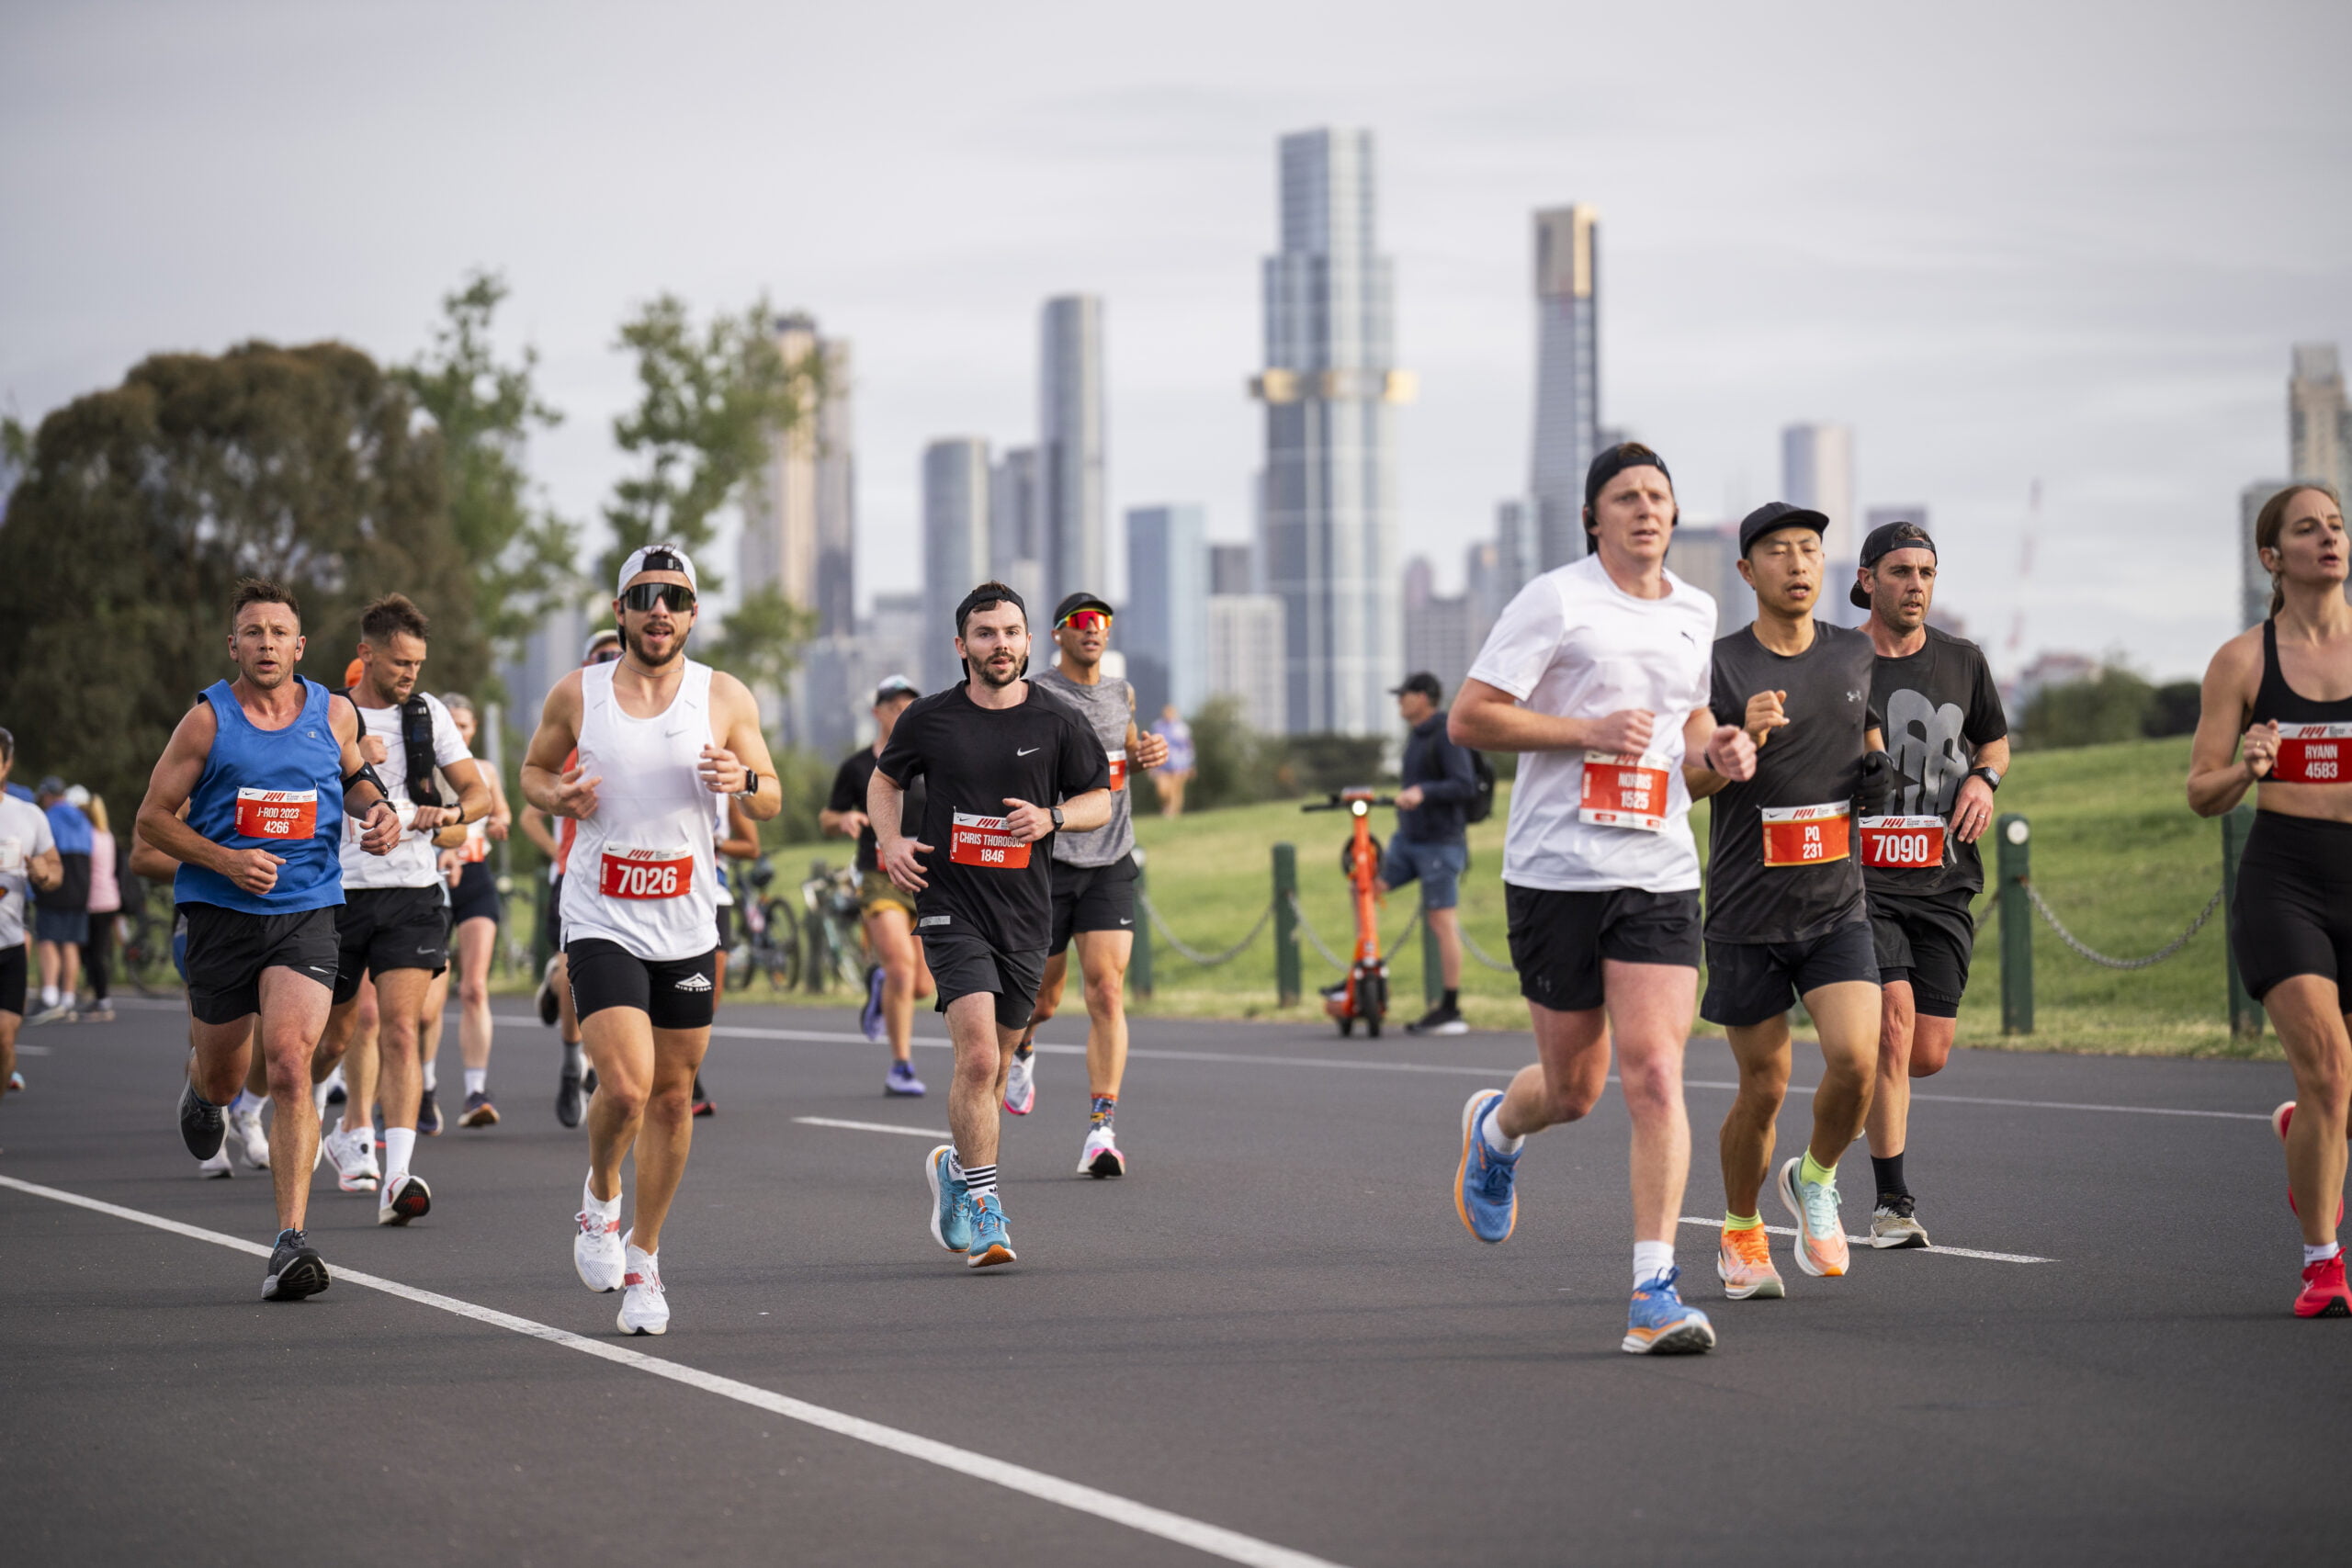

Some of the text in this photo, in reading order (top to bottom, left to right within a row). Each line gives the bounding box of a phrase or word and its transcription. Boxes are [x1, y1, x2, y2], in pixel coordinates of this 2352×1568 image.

[2305, 744, 2338, 760] RYANN
[2304, 761, 2338, 779] 4583
[256, 807, 279, 818] J-ROD
[279, 808, 300, 819] 2023
[264, 820, 290, 834] 4266
[1804, 826, 1820, 842] PQ
[959, 831, 982, 845] CHRIS
[980, 849, 1005, 863] 1846
[1803, 841, 1823, 859] 231
[1871, 834, 1928, 863] 7090
[616, 863, 678, 896] 7026
